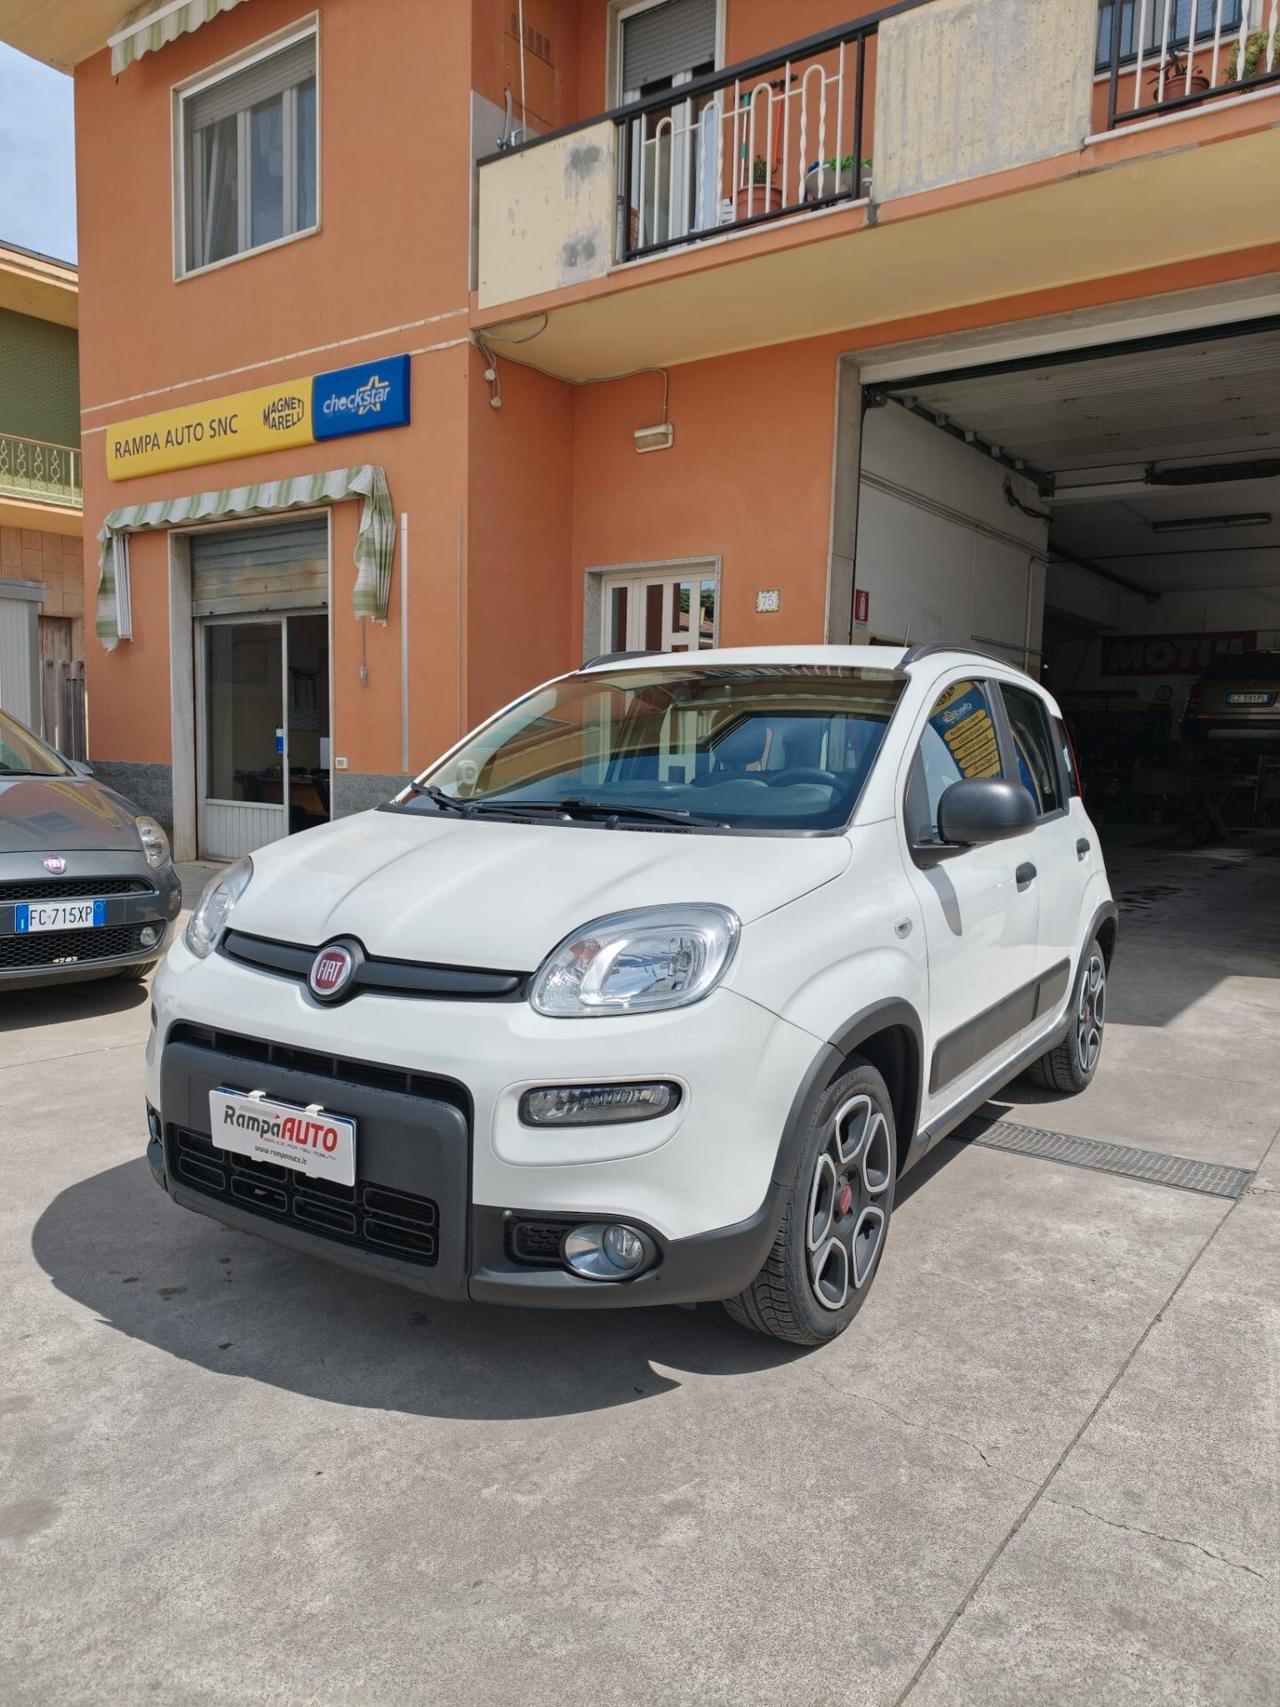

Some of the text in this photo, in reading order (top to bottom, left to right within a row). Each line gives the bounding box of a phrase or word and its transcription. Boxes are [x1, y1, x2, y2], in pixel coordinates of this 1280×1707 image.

[323, 386, 391, 413] checkstar
[115, 414, 238, 459] RAMPA AUTO SNC
[762, 595, 774, 608] 75
[30, 909, 47, 926] FC
[51, 906, 92, 925] 715XP
[317, 959, 343, 982] FIAT
